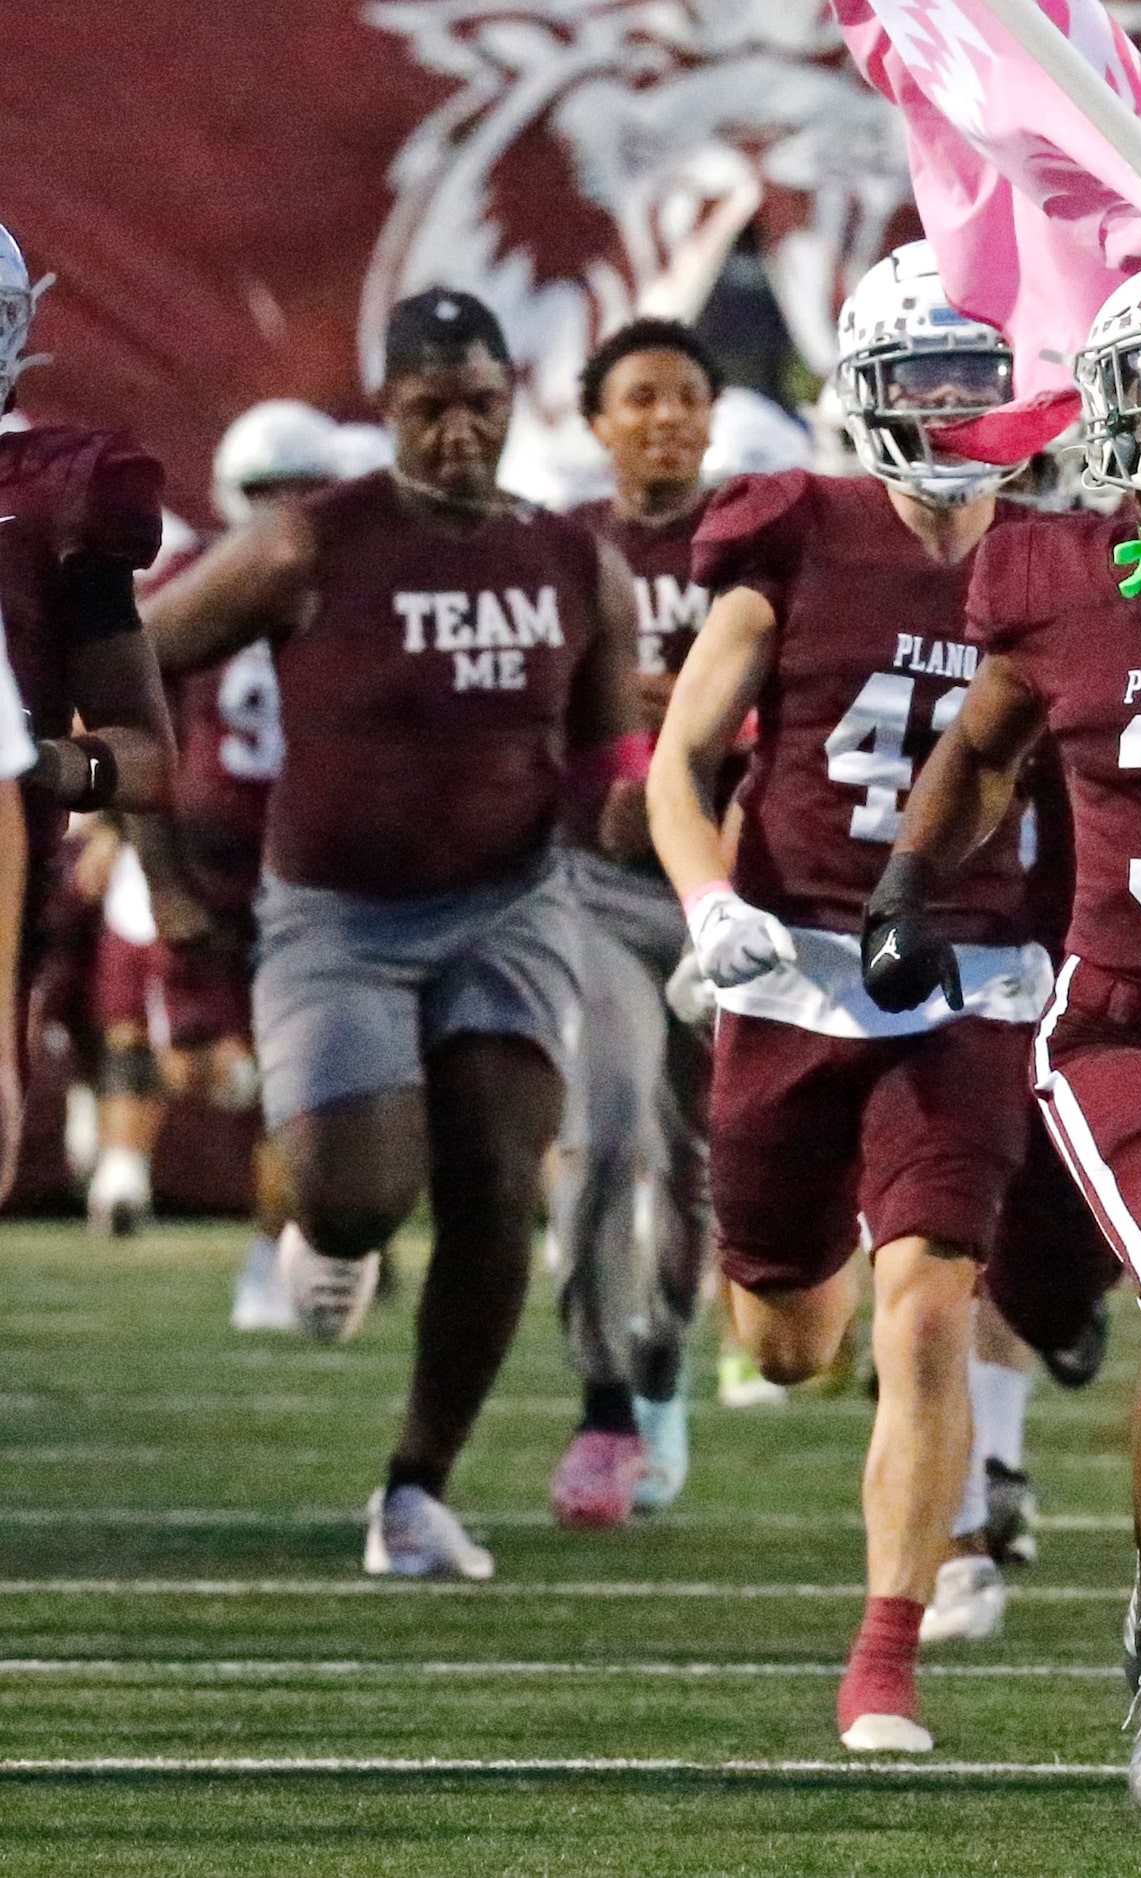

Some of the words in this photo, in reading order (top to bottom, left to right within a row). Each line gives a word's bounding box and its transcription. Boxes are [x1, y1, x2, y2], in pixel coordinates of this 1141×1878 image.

[392, 586, 565, 652] TEAM
[453, 650, 526, 692] ME
[893, 633, 978, 681] PLANO
